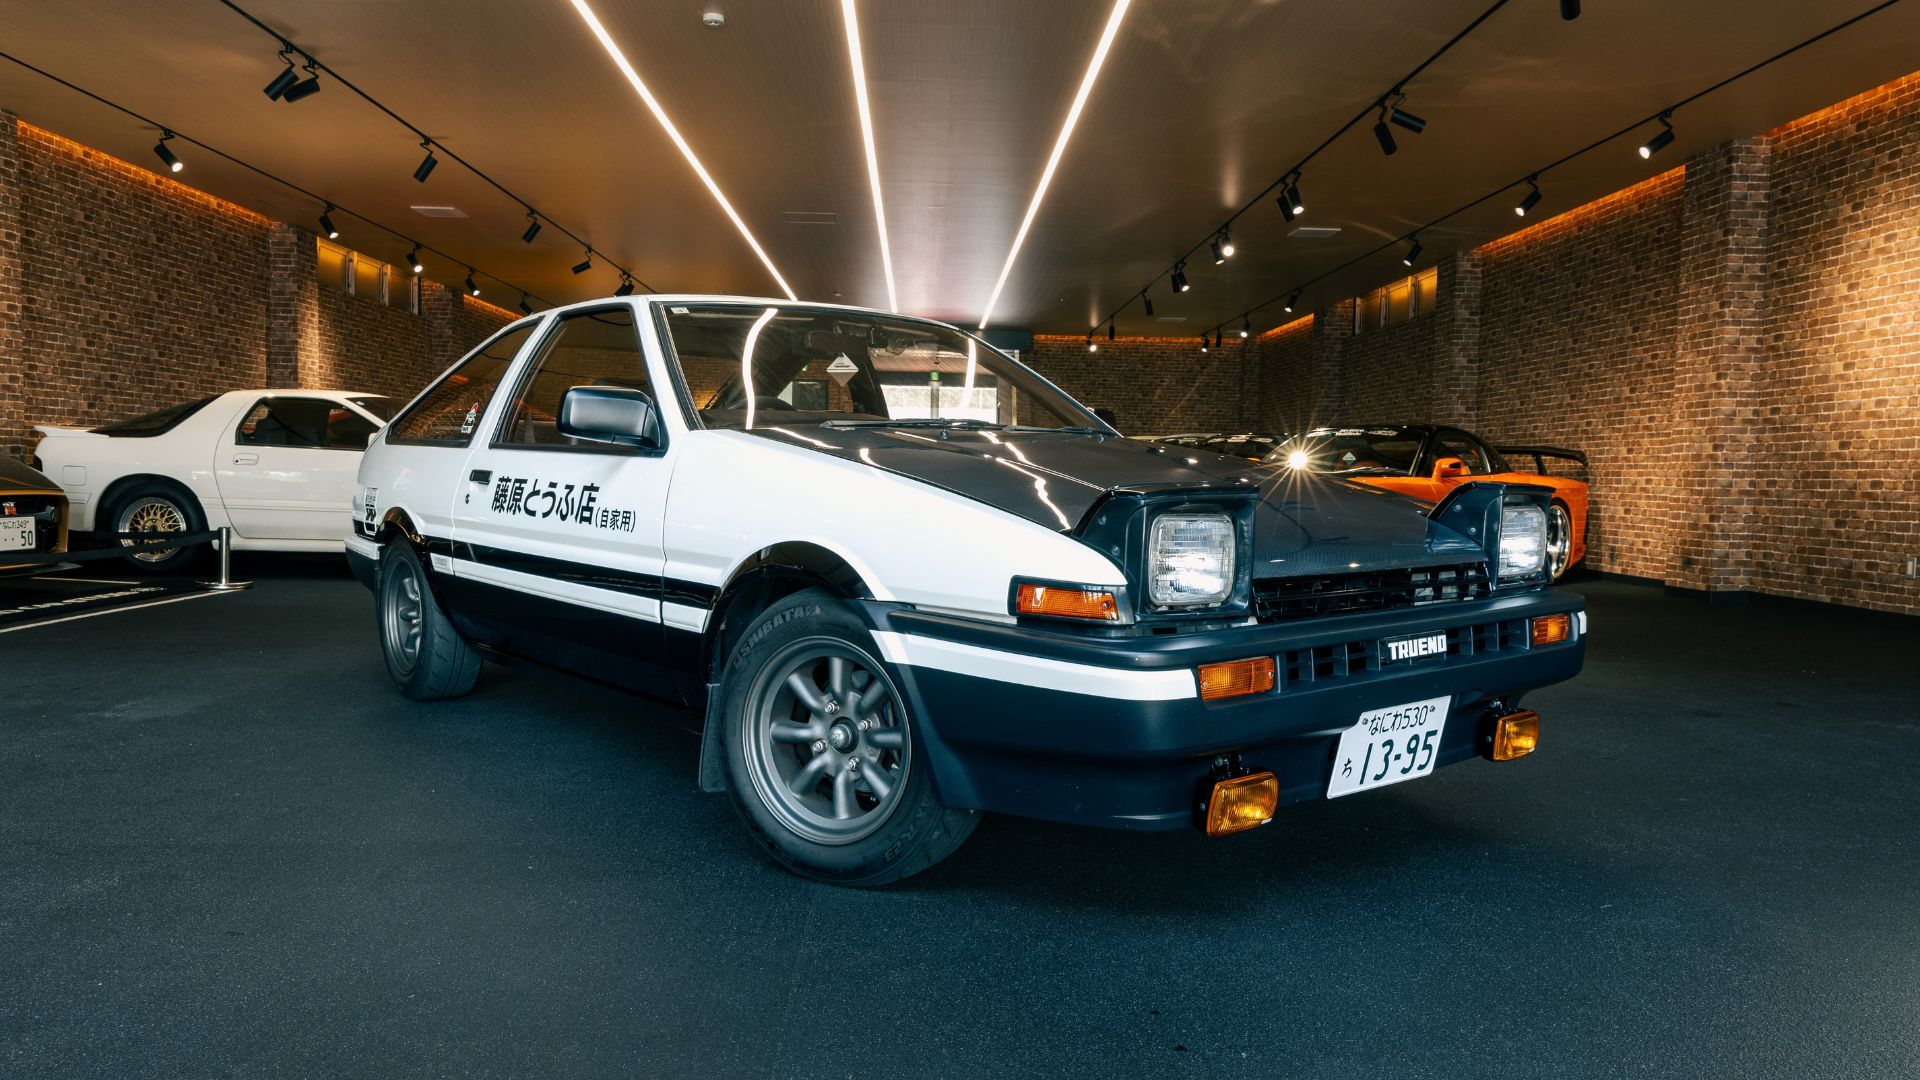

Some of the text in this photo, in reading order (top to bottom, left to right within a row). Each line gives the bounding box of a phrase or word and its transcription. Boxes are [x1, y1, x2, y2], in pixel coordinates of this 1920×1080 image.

[1388, 634, 1447, 661] TRUENO
[1369, 705, 1428, 736] なにわ530
[1341, 729, 1438, 785] ち 13-95
